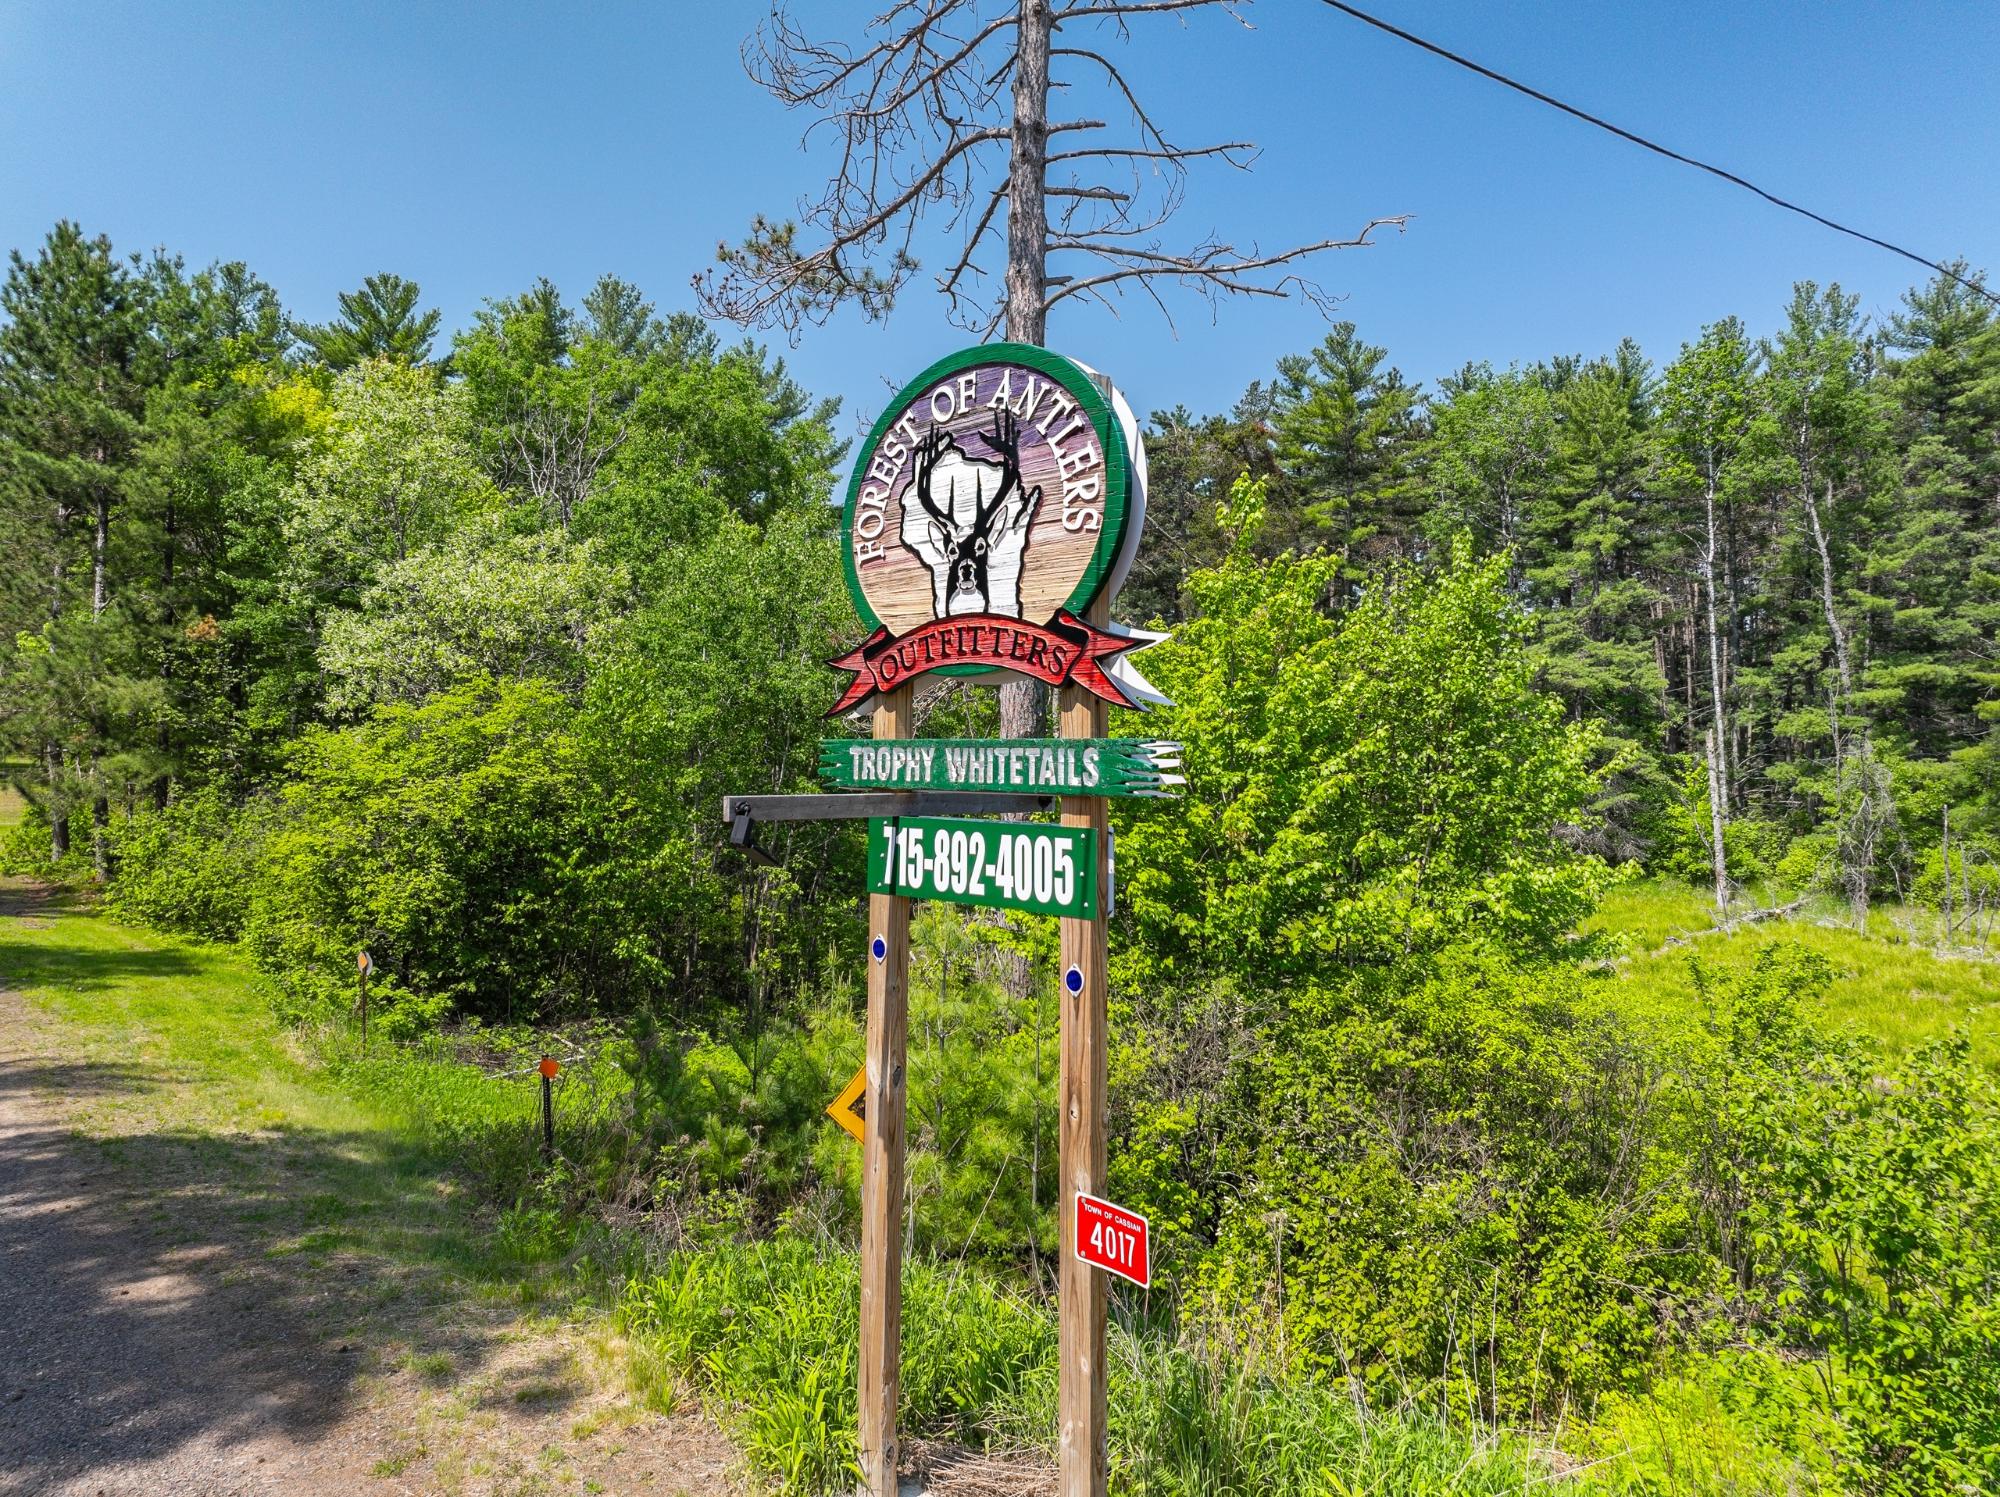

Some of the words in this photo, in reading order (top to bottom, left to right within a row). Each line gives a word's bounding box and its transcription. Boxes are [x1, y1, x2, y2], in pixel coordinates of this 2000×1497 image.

[855, 410, 922, 568] FOREST
[930, 371, 977, 423] OF
[987, 369, 1100, 533] ANTLERS
[880, 626, 1067, 681] OUTFITTERS
[850, 747, 936, 782] TROPHY
[946, 748, 1099, 788] WHITETAILS
[883, 826, 1074, 906] 715-892-4005
[1084, 1203, 1102, 1216] TOWN
[1104, 1211, 1113, 1219] OF
[1114, 1216, 1141, 1232] CASSIAN
[1090, 1221, 1136, 1267] 4017
